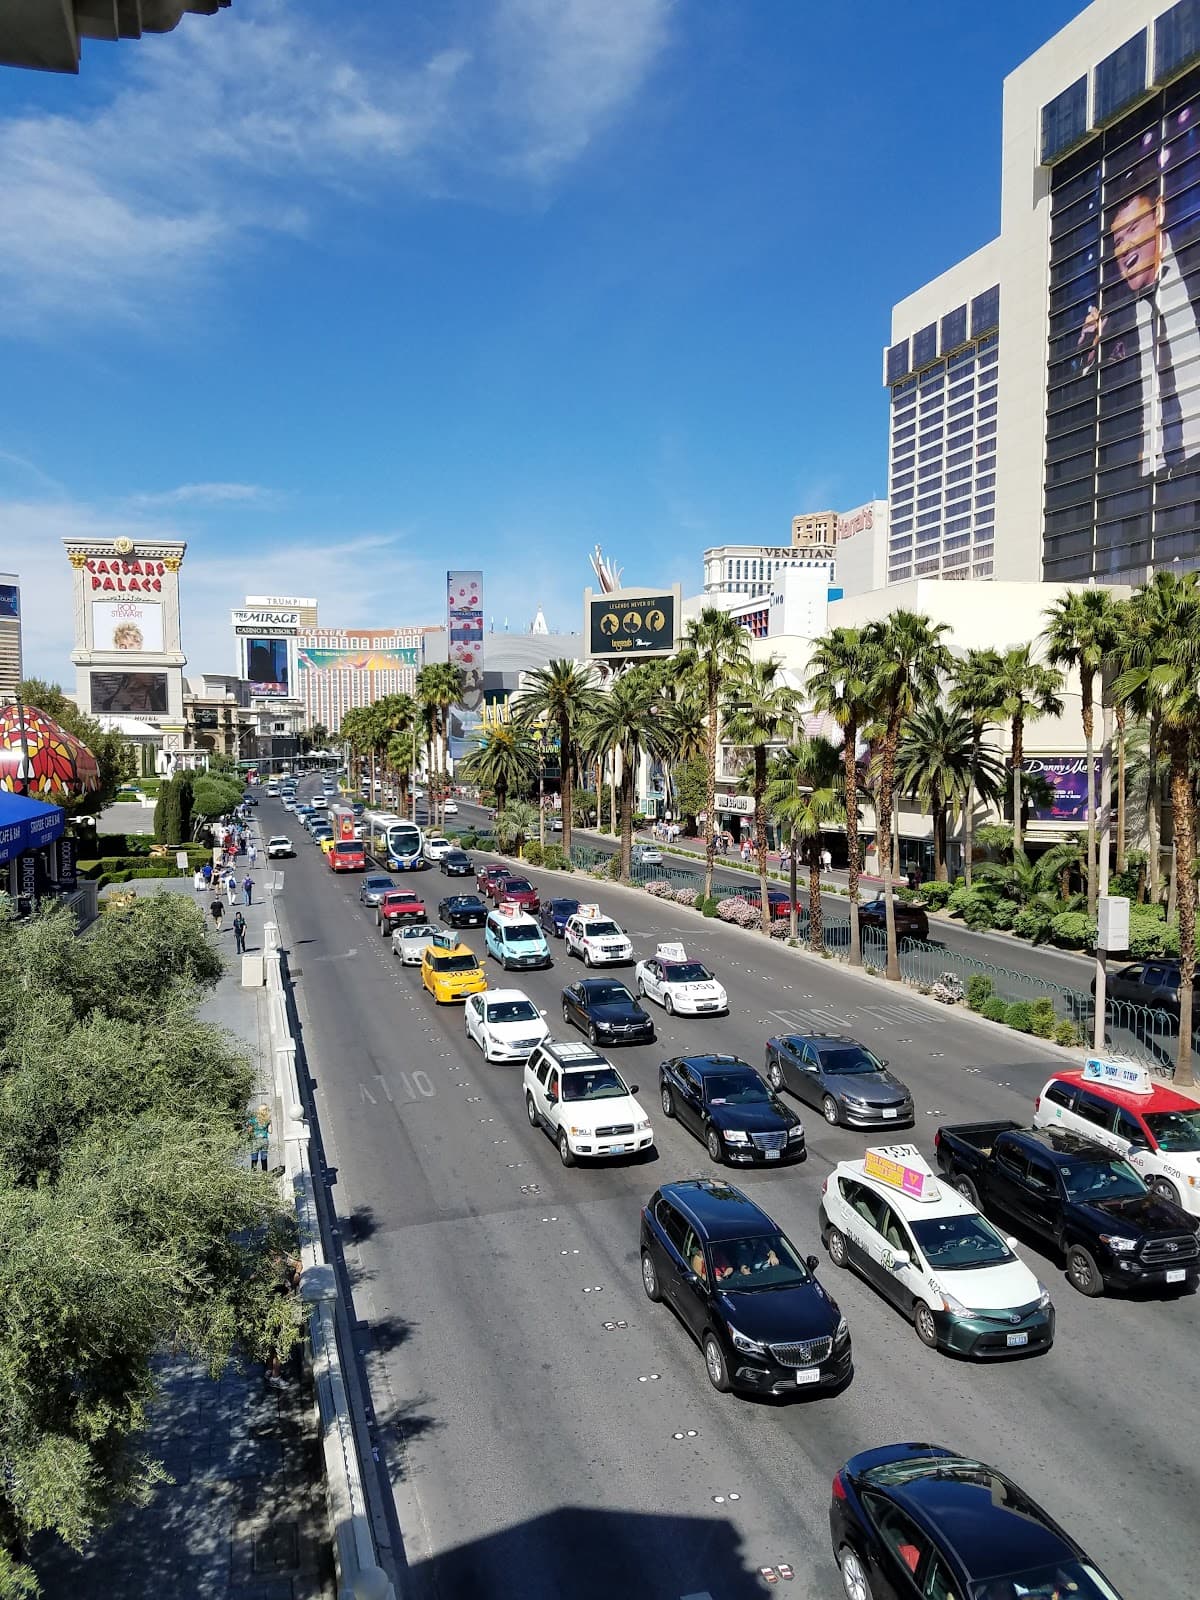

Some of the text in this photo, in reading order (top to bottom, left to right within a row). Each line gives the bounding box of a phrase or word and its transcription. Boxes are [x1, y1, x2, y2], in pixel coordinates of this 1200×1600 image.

[764, 548, 834, 559] VENETIAN
[84, 560, 165, 577] CAESARS
[91, 576, 162, 592] PALACE
[117, 604, 137, 612] ROD
[609, 602, 630, 610] LEGENDS
[240, 613, 298, 624] MIRAGE
[299, 629, 347, 637] TREASURE
[394, 628, 423, 636] ISLAND
[62, 841, 72, 877] COCKTAILS
[1163, 1164, 1181, 1179] 6520
